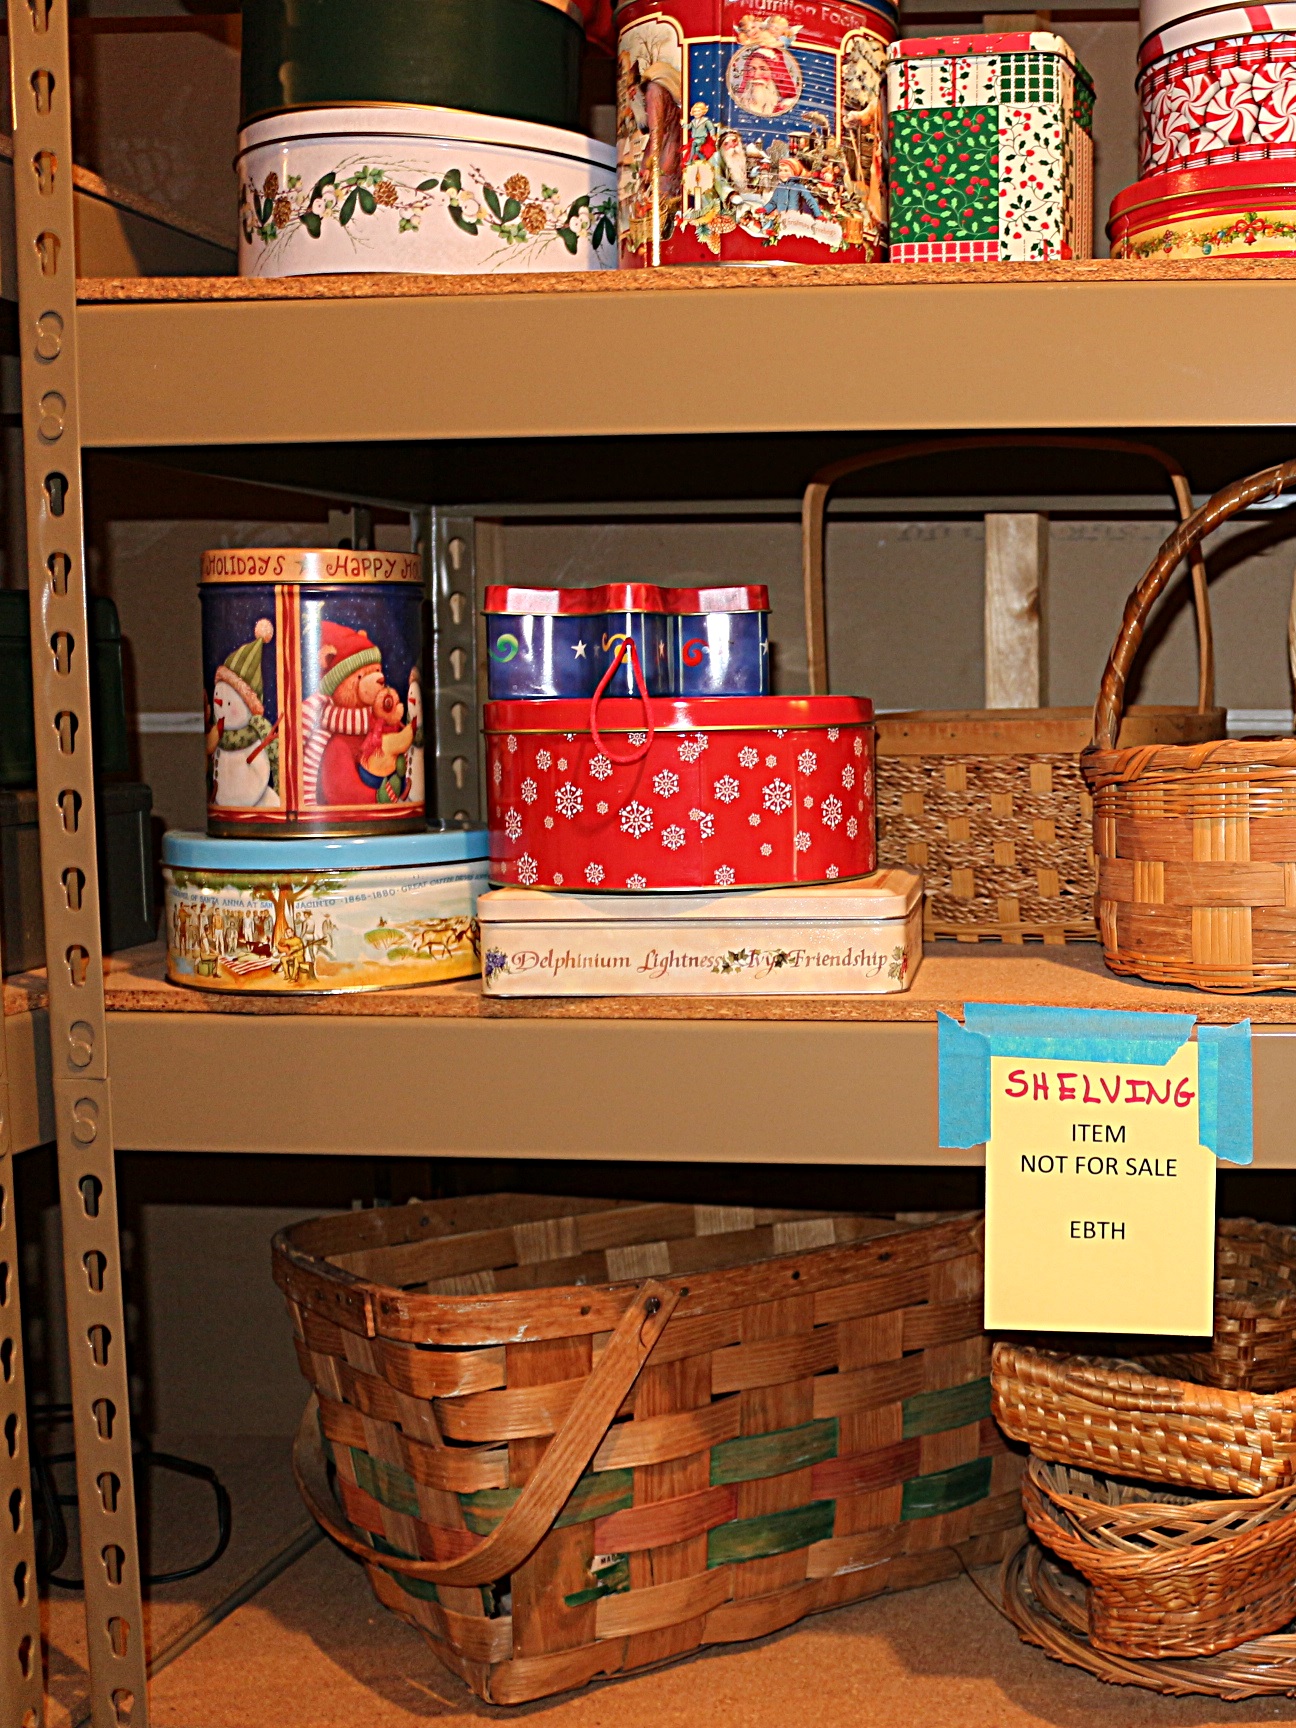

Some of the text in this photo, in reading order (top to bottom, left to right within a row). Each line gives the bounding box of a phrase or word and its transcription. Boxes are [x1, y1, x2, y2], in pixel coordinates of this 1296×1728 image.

[200, 895, 218, 905] SANTA
[223, 899, 244, 907] ANNA
[296, 899, 335, 909] JACINTO
[511, 949, 631, 977] Delphinium
[637, 949, 724, 979] Lightness
[788, 949, 888, 979] Friendship
[1005, 1069, 1195, 1107] SHELVING
[1072, 1124, 1126, 1143] ITEM
[1021, 1155, 1177, 1177] NOT FOR SALE
[1070, 1221, 1125, 1240] EBTH
